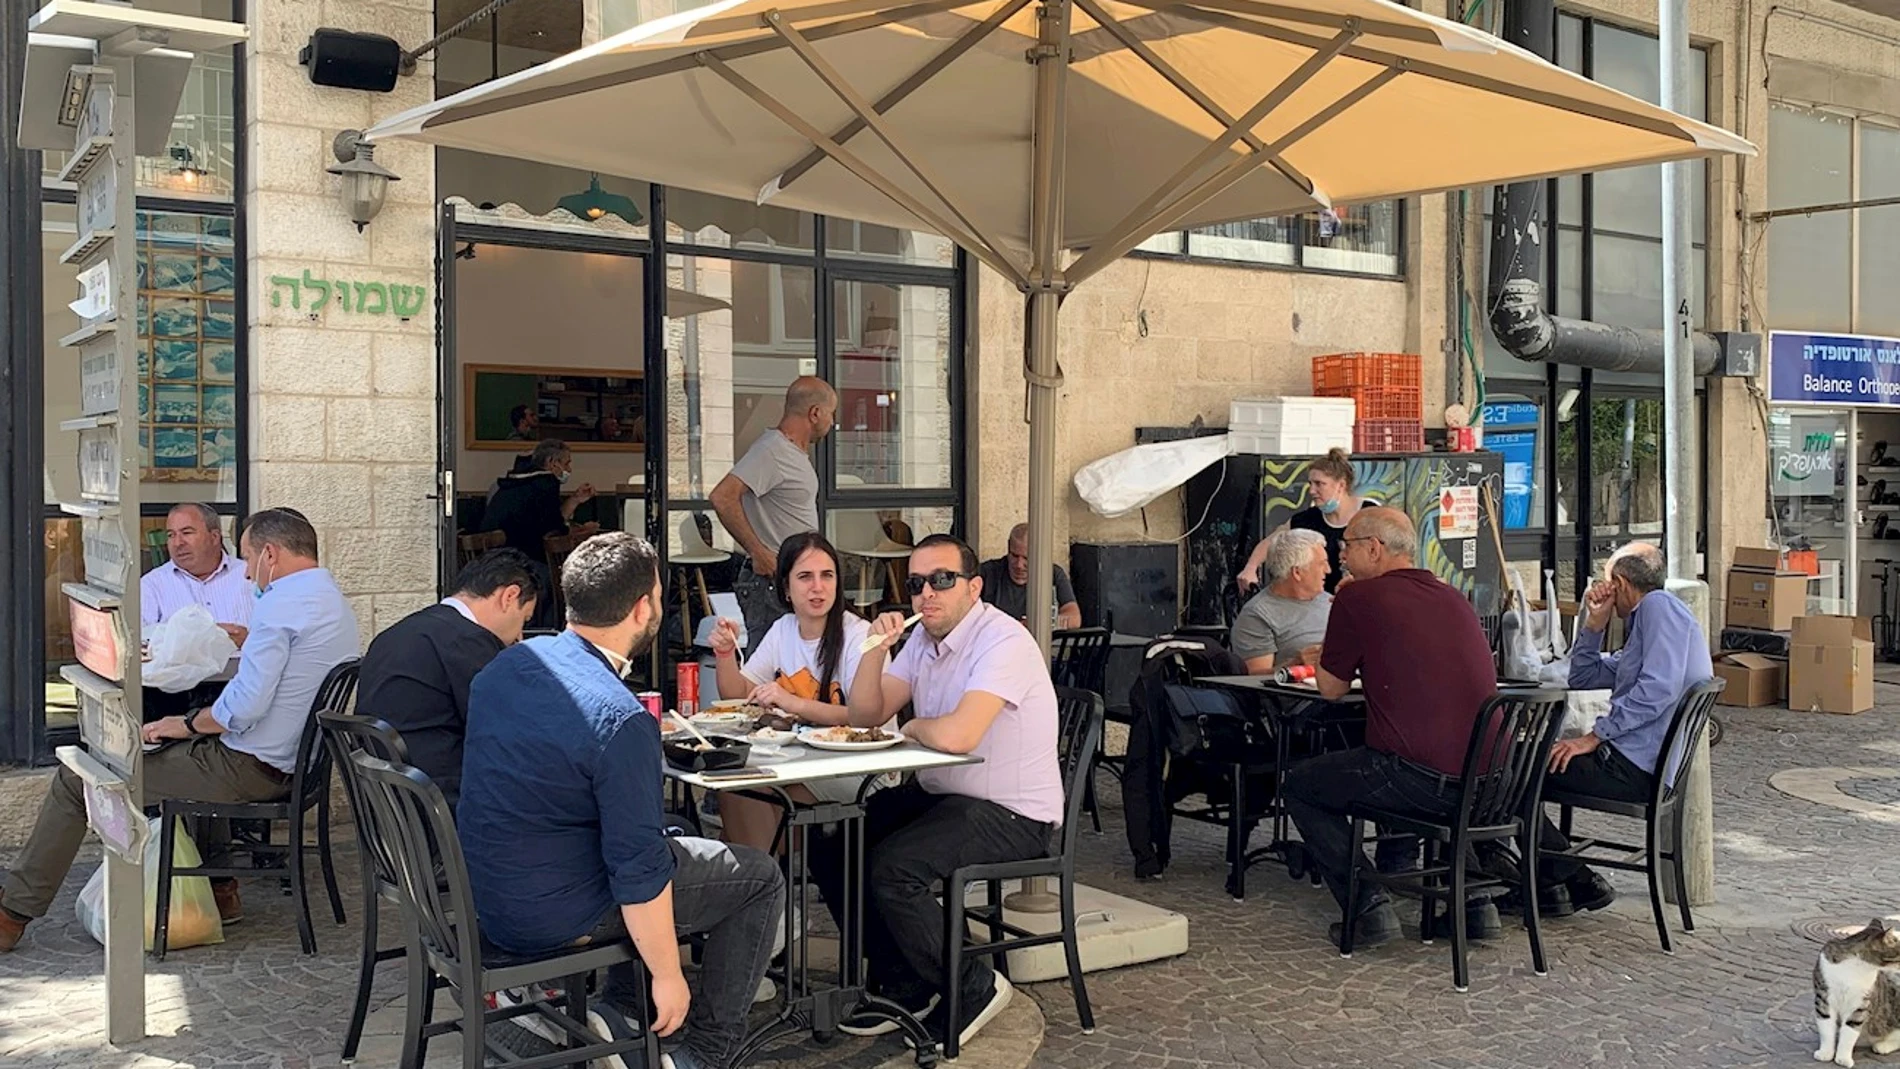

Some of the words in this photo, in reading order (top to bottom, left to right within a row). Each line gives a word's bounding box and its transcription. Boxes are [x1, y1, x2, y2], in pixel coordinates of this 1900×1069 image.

[271, 269, 425, 317] שמולה
[1803, 344, 1872, 362] אורטופדיה
[1803, 374, 1853, 393] Balance
